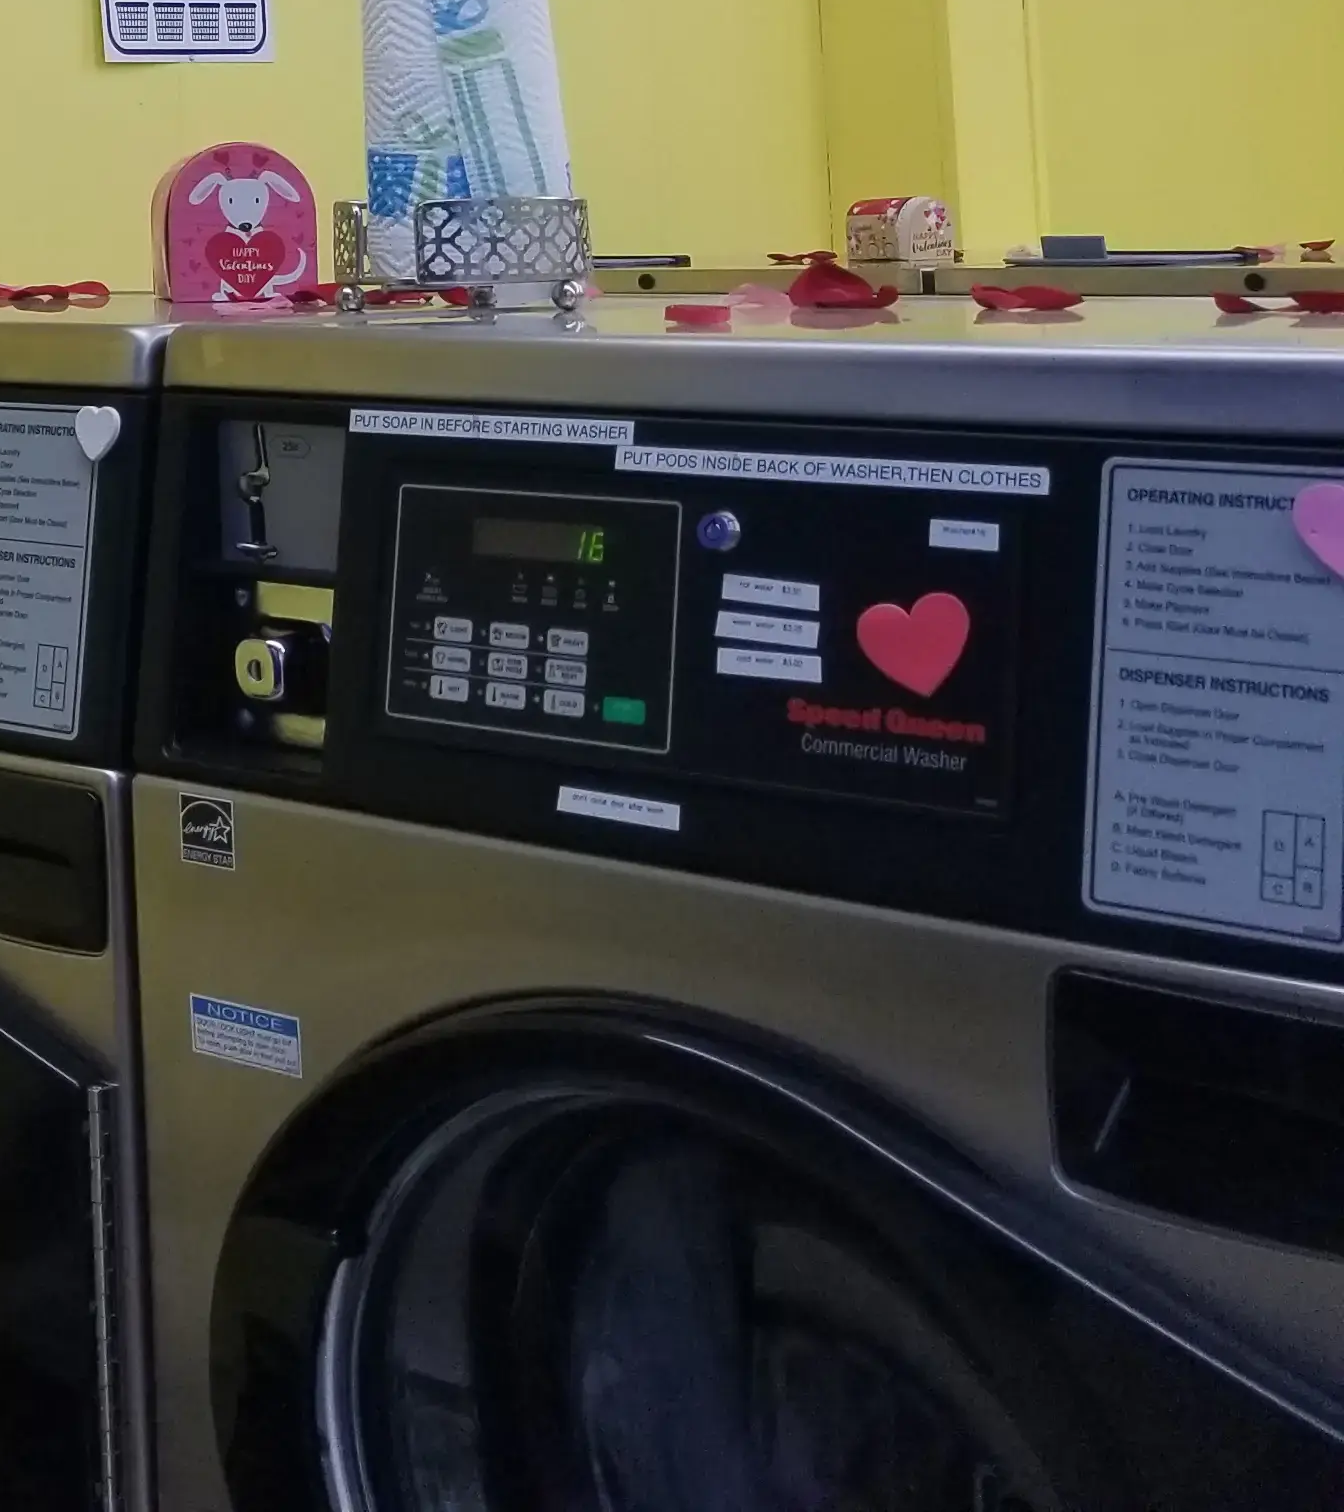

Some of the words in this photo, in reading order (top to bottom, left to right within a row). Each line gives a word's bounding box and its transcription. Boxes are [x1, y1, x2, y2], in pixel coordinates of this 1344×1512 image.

[233, 247, 260, 257] HAPPY
[238, 274, 256, 283] DAY
[27, 424, 75, 436] INSTRUCTIO
[354, 415, 380, 428] PUT
[382, 416, 417, 430] SOAP
[420, 418, 434, 431] IN
[437, 419, 489, 434] BEFORE
[494, 421, 562, 437] STARTING
[566, 424, 628, 440] WASHER
[623, 451, 652, 466] PUT
[656, 452, 698, 469] PODS
[702, 454, 753, 473] INSIDE
[757, 458, 799, 476] BACK
[803, 460, 826, 477] OF
[958, 469, 1042, 489] CLOTHES
[1127, 488, 1213, 508] OPERATING
[1218, 492, 1296, 512] INSTRUCT
[16, 552, 76, 568] INSTRUCTIONS
[1119, 667, 1206, 690] DISPENSER
[1210, 676, 1331, 703] INSTRUCTIONS
[786, 697, 882, 730] Speed
[885, 707, 986, 744] Queen
[800, 732, 898, 764] Commercial
[903, 745, 968, 771] Washer
[208, 1003, 283, 1031] NOTICE
